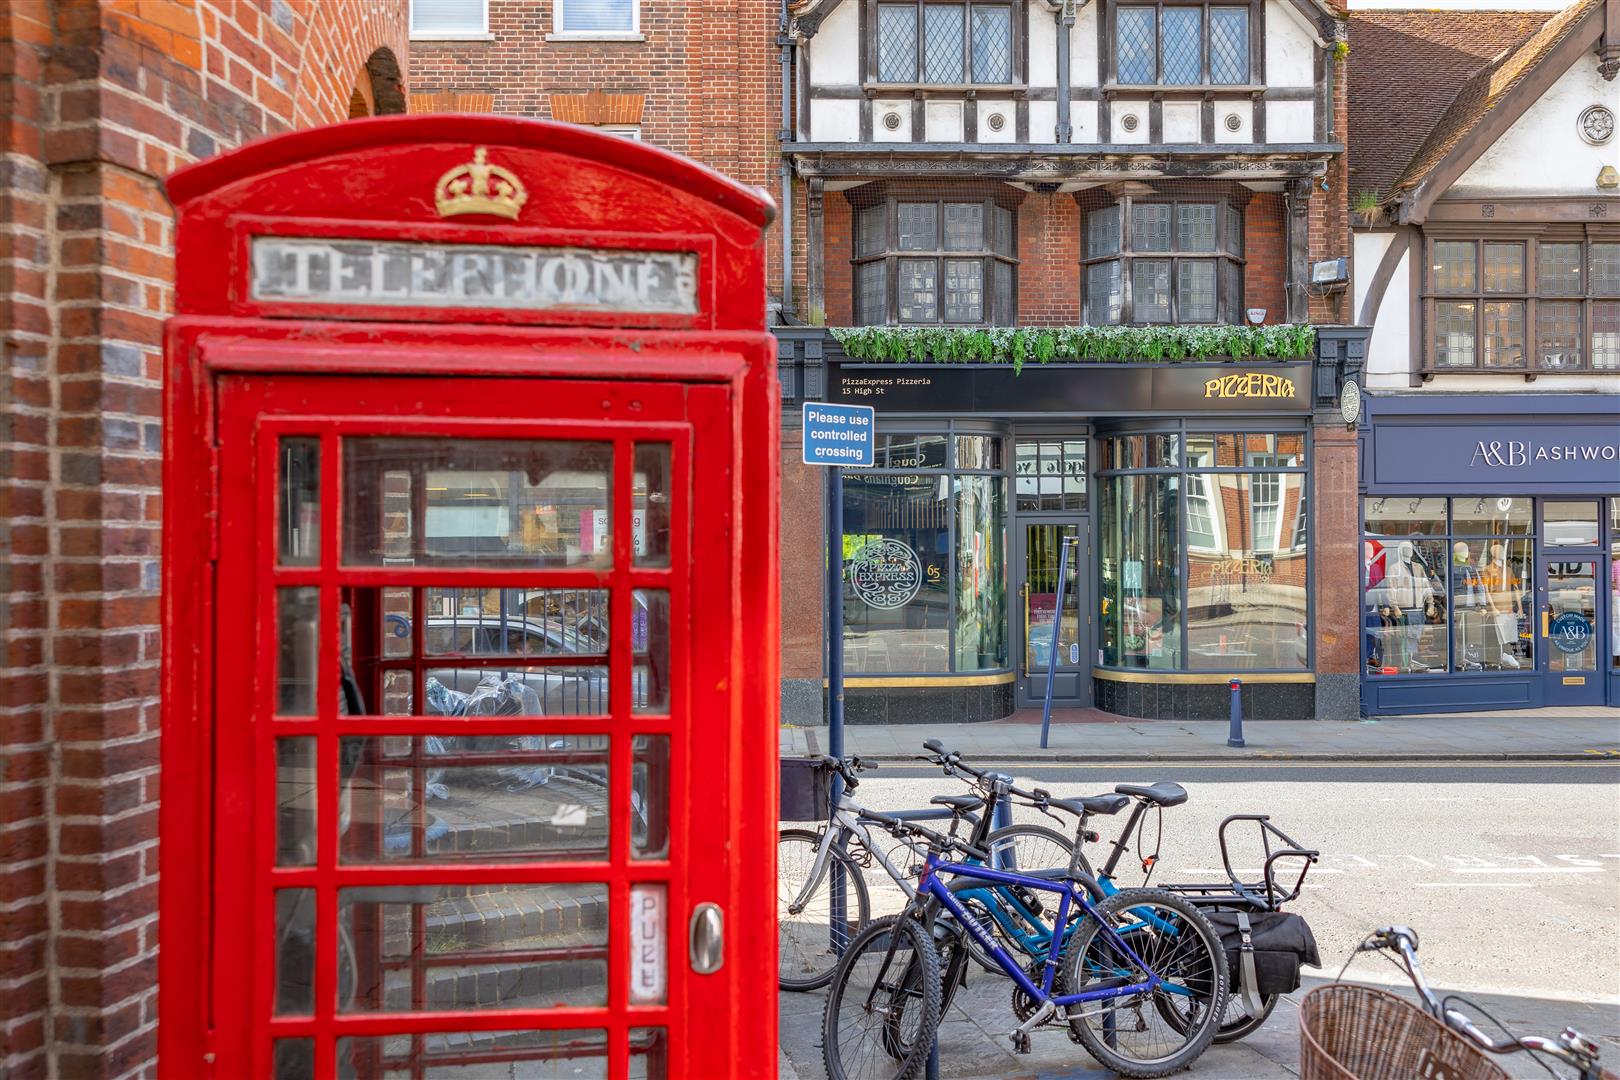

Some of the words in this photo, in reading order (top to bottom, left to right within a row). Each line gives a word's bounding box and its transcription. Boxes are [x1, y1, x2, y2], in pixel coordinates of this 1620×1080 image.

[279, 246, 670, 306] TELEPHONE
[842, 378, 893, 387] PizzaExpress
[896, 377, 931, 385] Pizzeria
[1204, 372, 1295, 398] PIZZERIA
[842, 387, 851, 395] 15
[854, 387, 872, 396] High
[875, 387, 885, 395] St
[808, 411, 846, 425] Please
[849, 416, 869, 426] use
[811, 429, 867, 442] controlled
[815, 446, 863, 461] crossing
[1469, 441, 1527, 467] A&B
[1535, 446, 1620, 461] ASHWO
[869, 563, 908, 573] PIZZA
[927, 564, 940, 579] 65
[859, 572, 915, 581] EXPRESS
[1560, 625, 1586, 641] A&B
